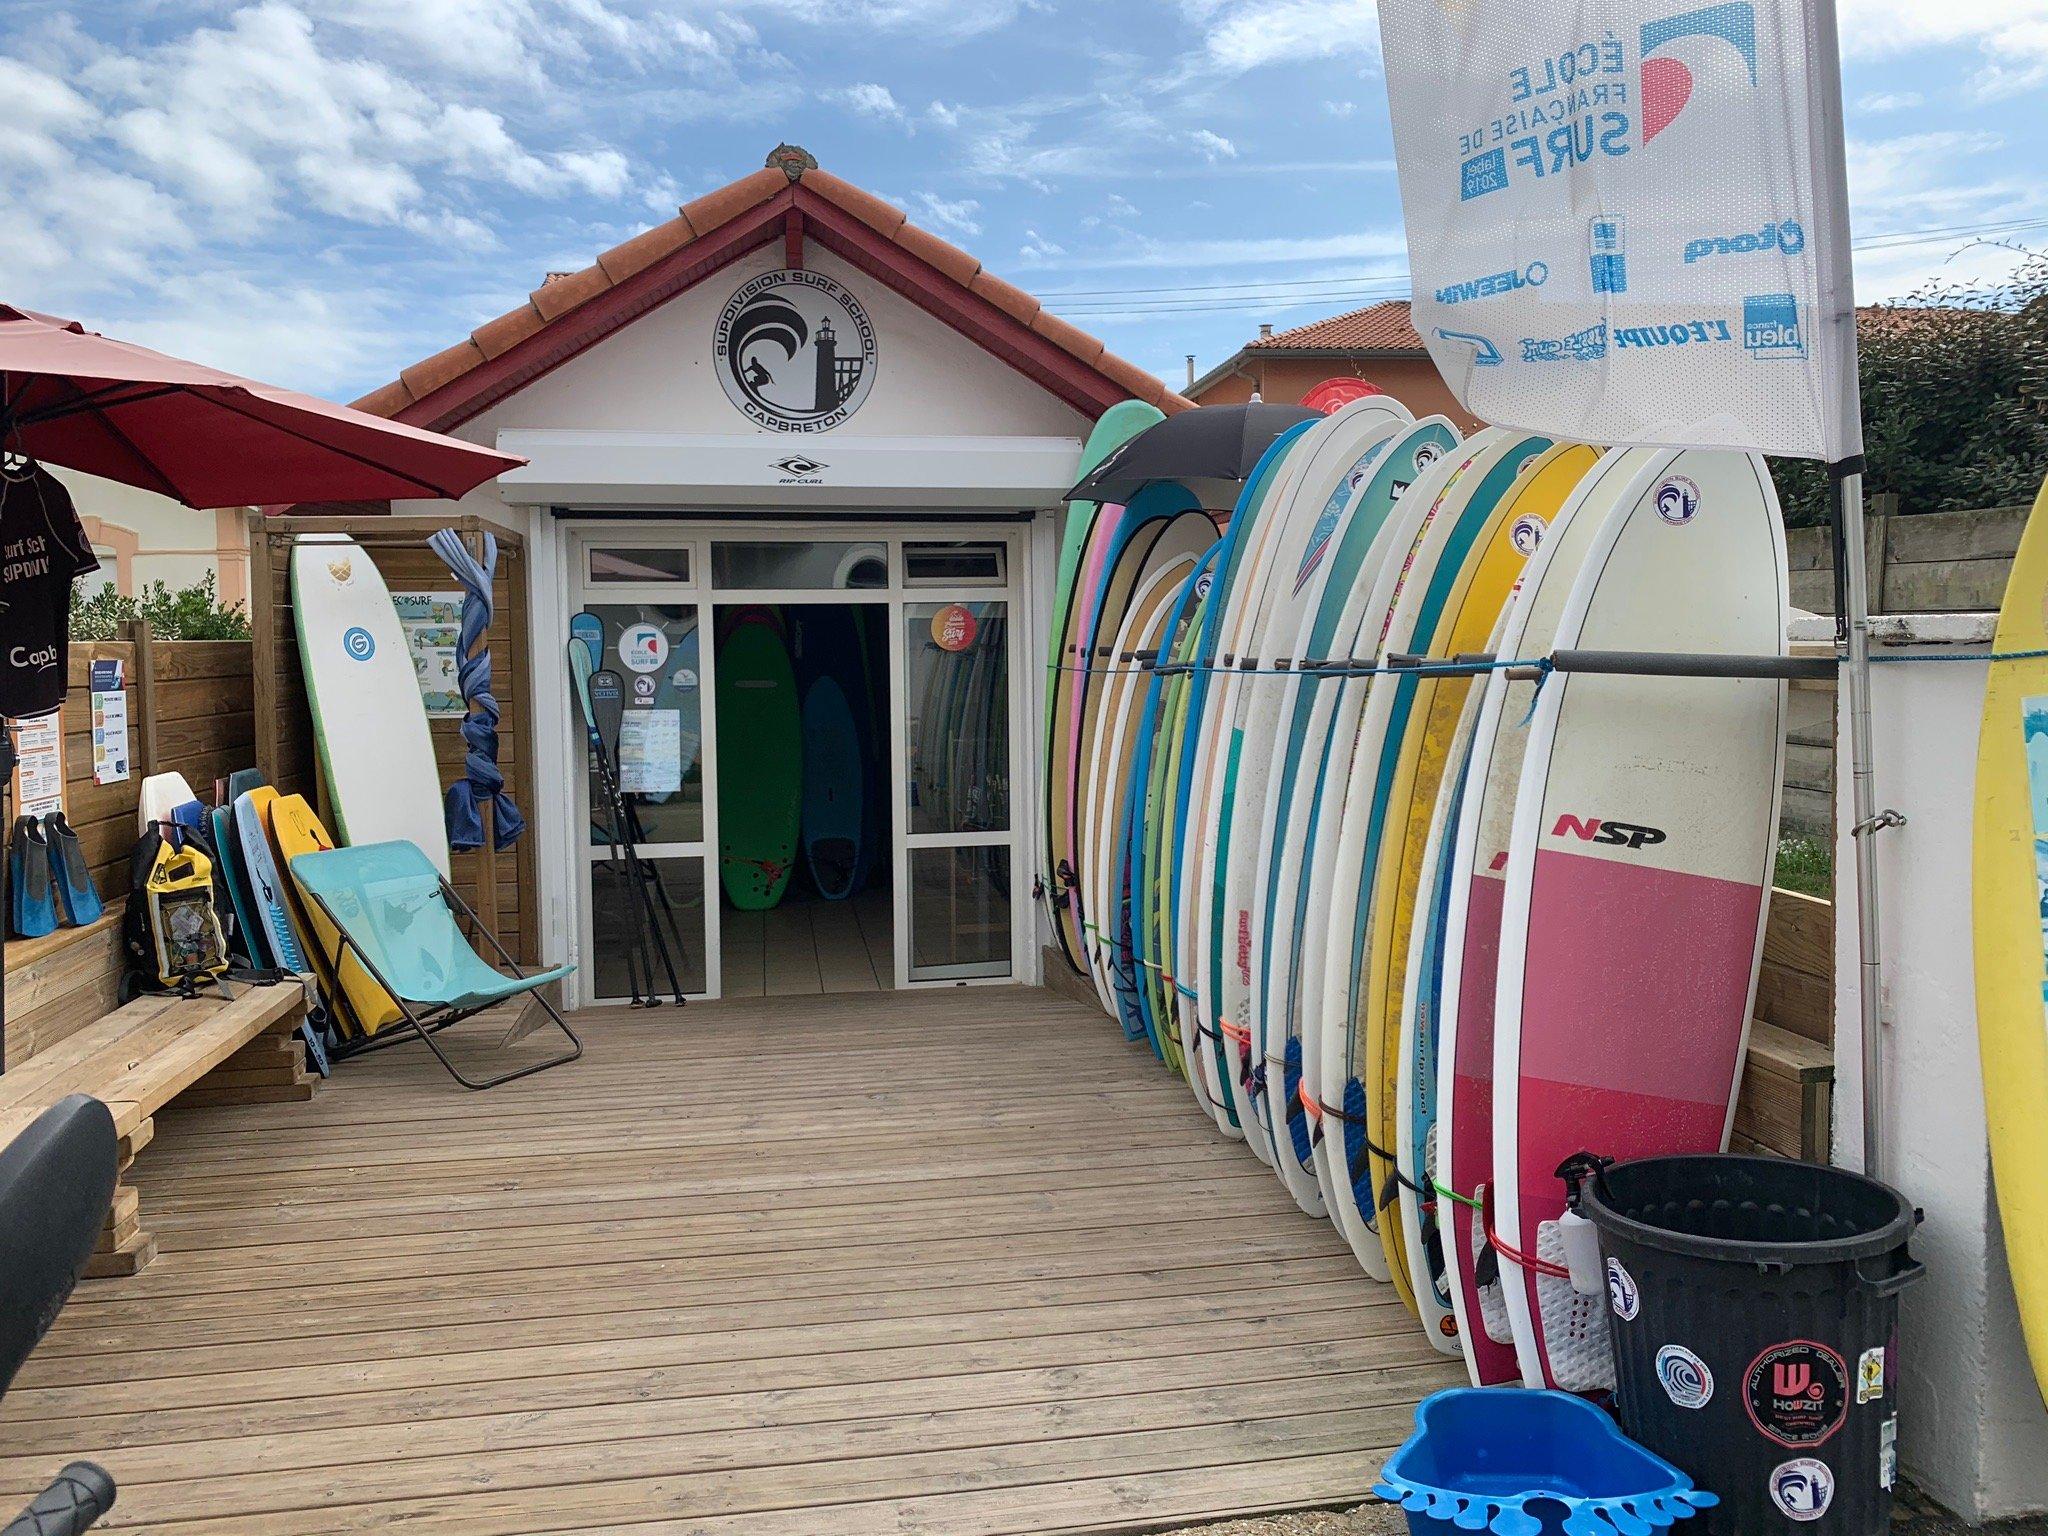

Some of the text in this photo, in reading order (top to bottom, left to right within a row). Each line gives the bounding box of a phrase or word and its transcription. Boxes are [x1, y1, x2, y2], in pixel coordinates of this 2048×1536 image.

[717, 272, 875, 361] SUPDIVISION SURF SCHOOL
[743, 402, 849, 433] CAPBRETON
[1551, 813, 1667, 850] NSP
[1751, 1347, 1810, 1391] AUTHORIZED
[1816, 1351, 1846, 1389] DEALER
